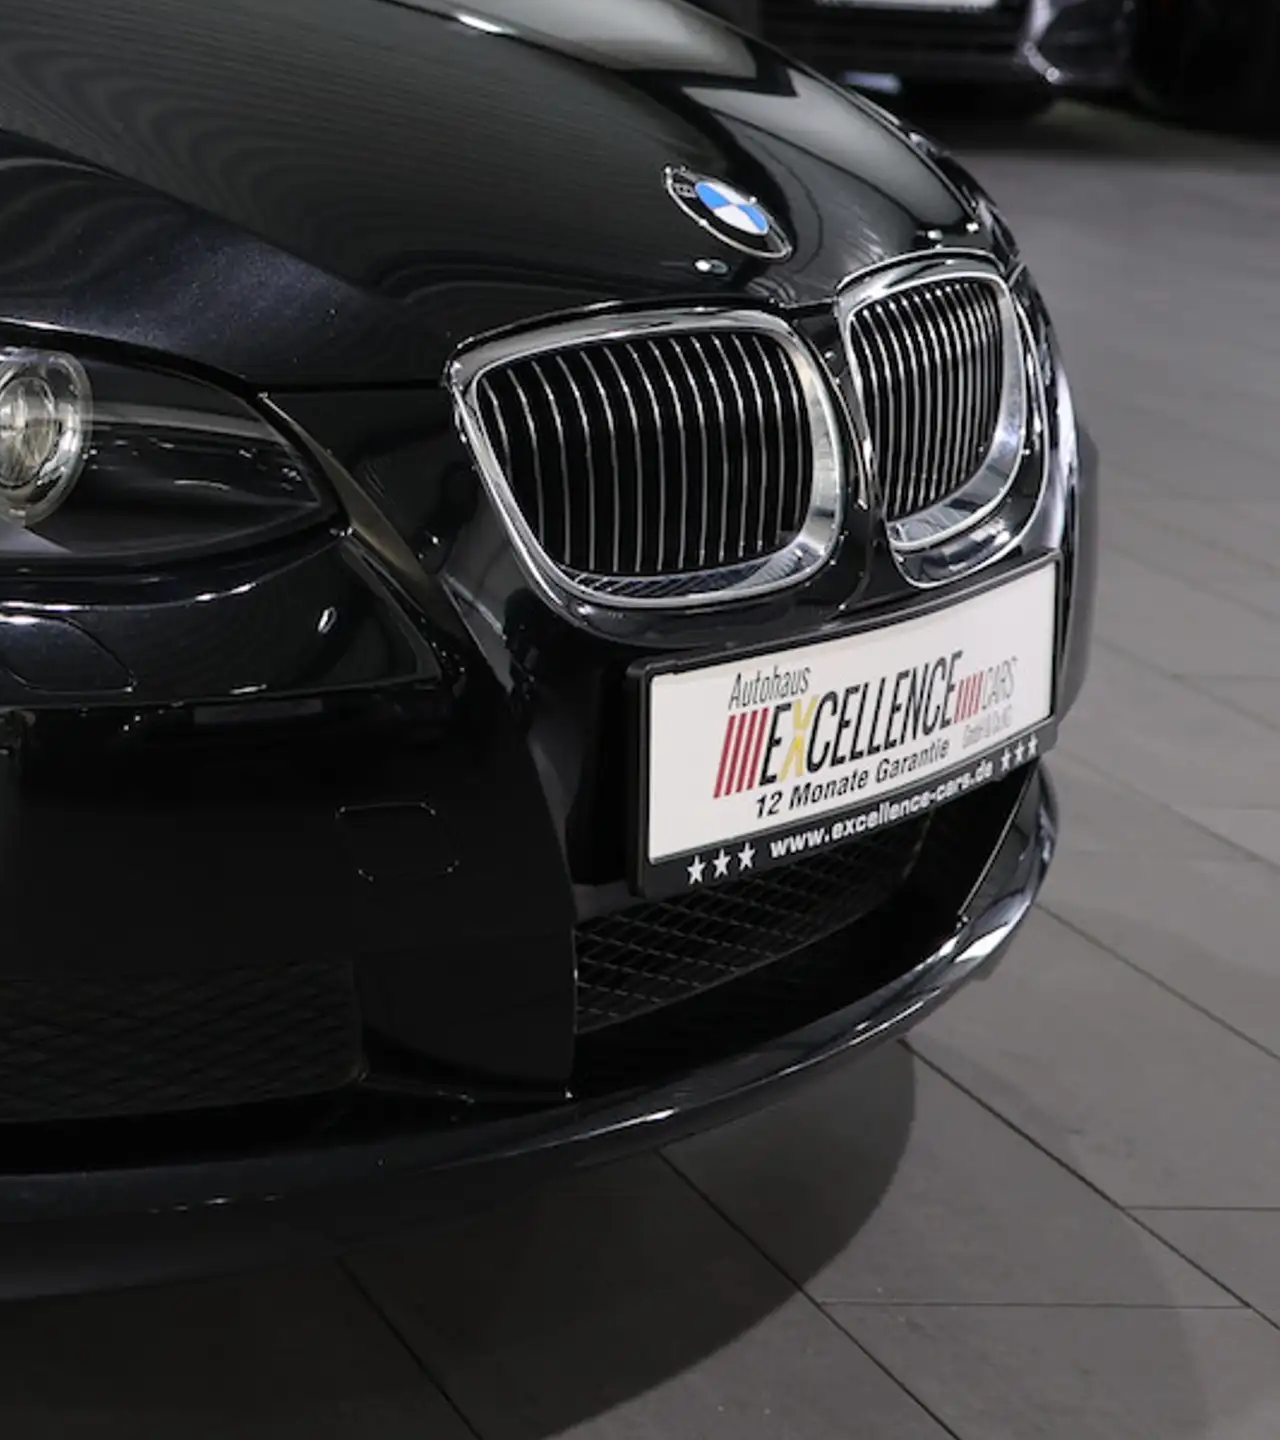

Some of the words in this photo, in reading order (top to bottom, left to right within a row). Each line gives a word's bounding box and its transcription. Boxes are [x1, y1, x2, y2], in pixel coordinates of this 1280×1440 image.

[728, 665, 811, 710] Autohaus
[758, 649, 963, 788] EXCELLENCE
[755, 790, 783, 820] 12
[789, 767, 869, 811] Monate
[875, 736, 950, 784] Garantie
[769, 760, 994, 859] www.excellence-cars.de
